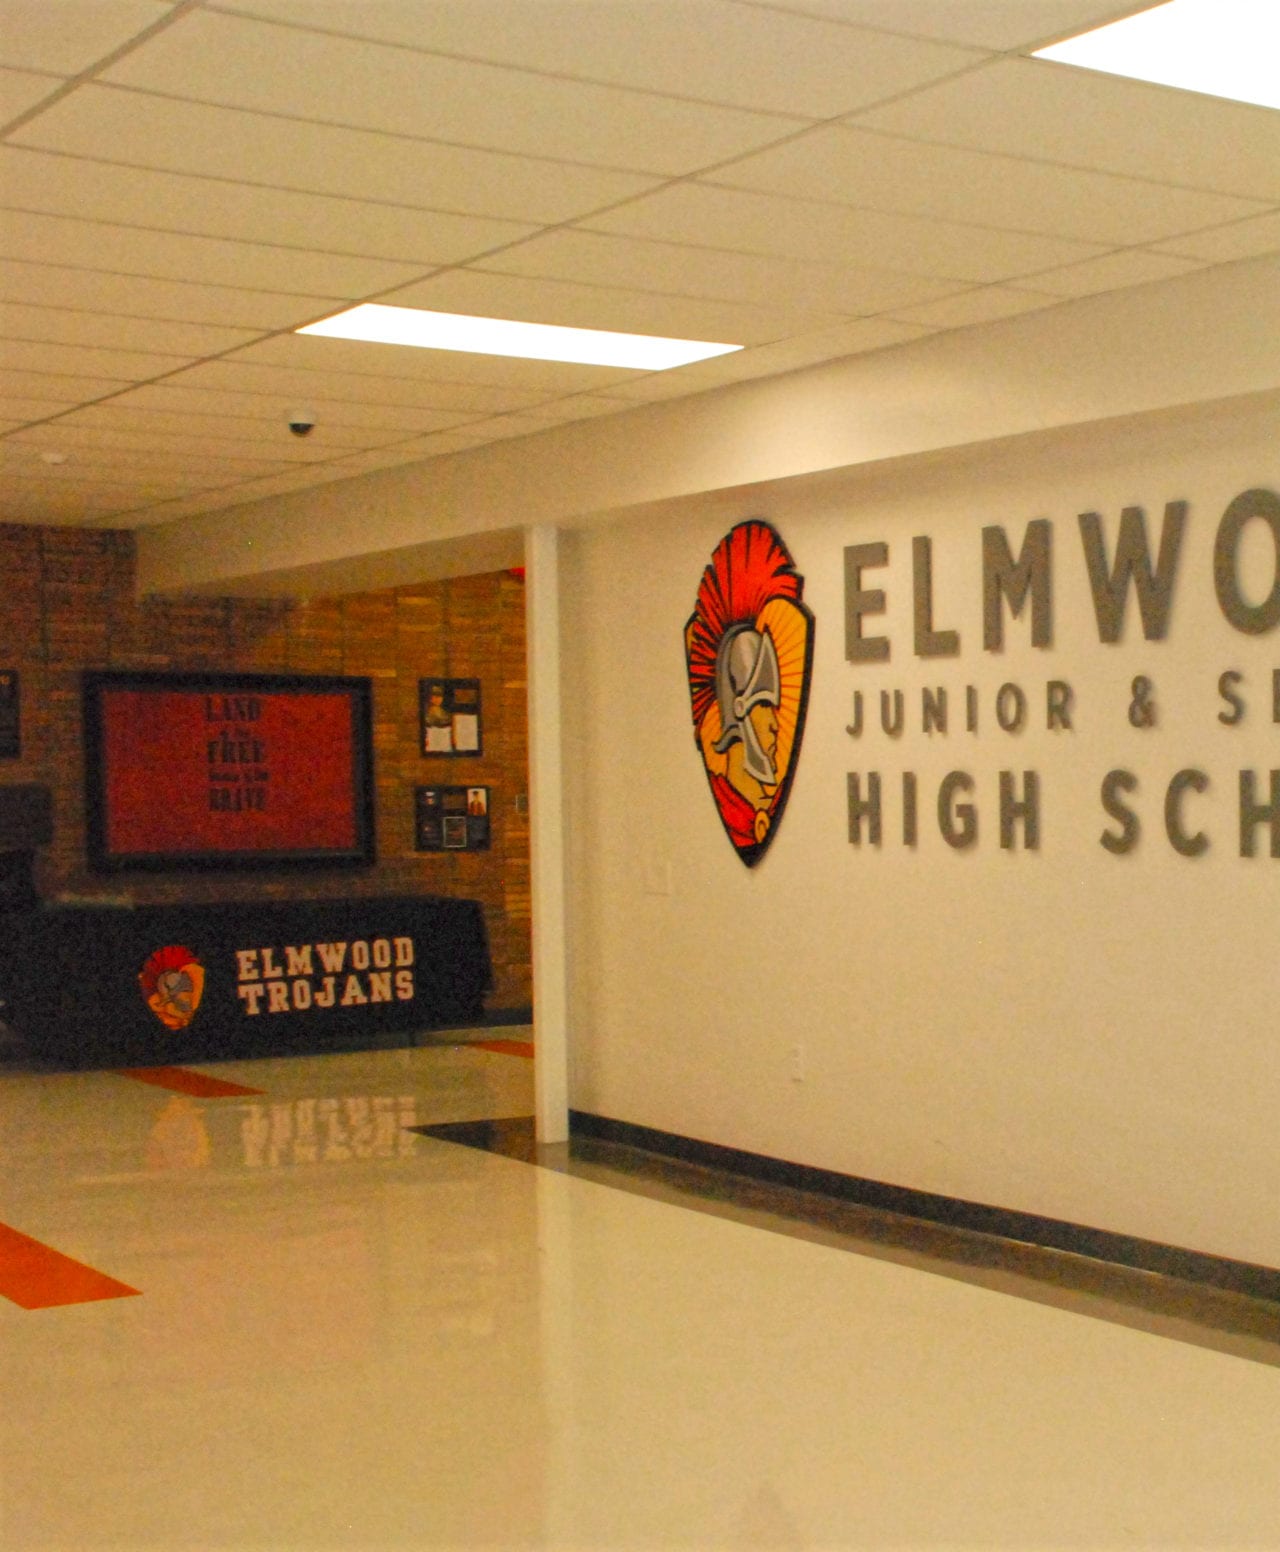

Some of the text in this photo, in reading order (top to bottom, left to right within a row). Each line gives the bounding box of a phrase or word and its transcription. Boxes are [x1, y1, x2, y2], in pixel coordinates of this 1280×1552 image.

[845, 680, 1074, 736] JUNIOR
[1128, 675, 1156, 729] &
[207, 740, 267, 763] FREE
[847, 770, 1040, 850] HIGH
[235, 936, 415, 981] ELMWOOD
[237, 970, 415, 1016] TROJANS
